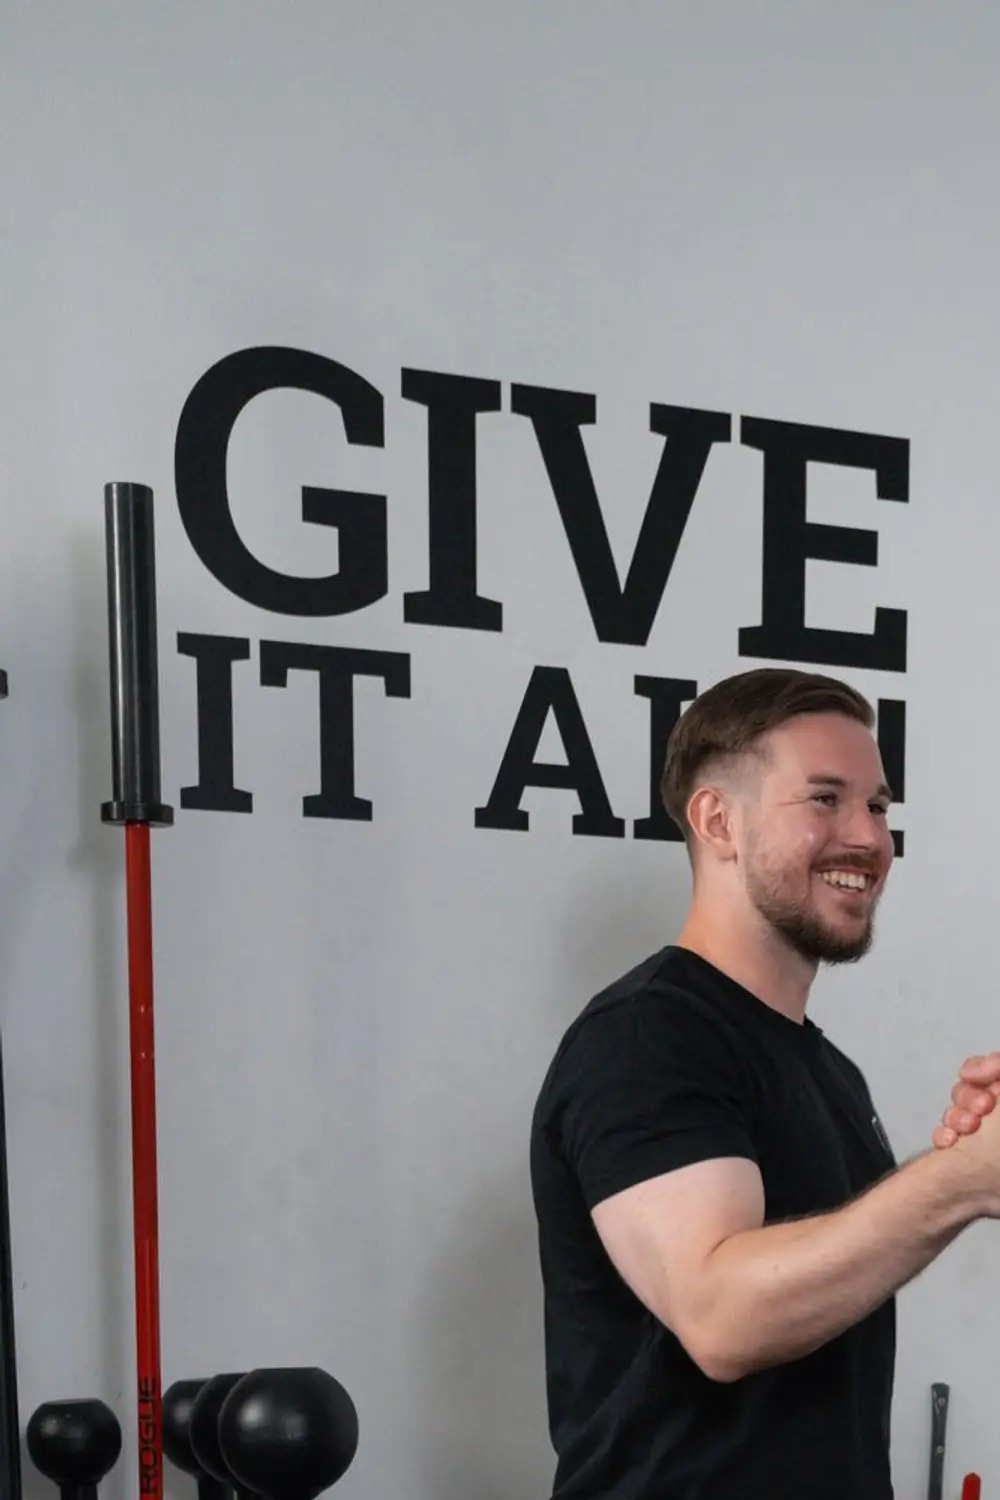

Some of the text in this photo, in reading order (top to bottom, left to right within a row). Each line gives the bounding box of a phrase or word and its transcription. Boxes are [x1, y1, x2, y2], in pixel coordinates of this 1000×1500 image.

[174, 345, 910, 672] GIVE
[176, 631, 411, 821] IT
[139, 1375, 158, 1494] ROGUE
